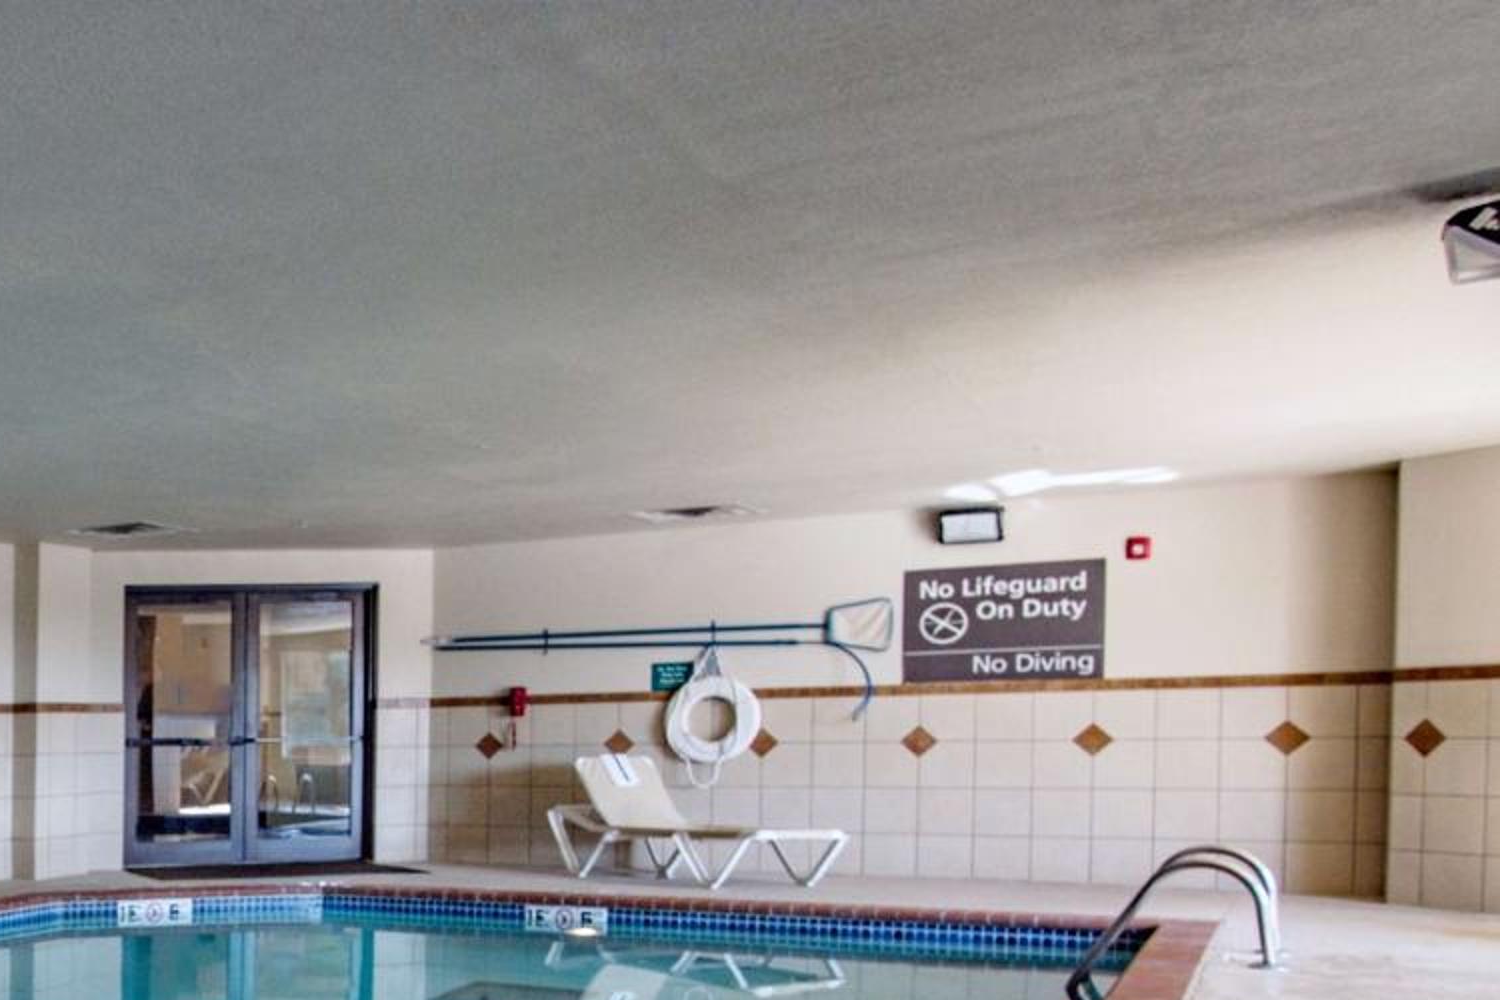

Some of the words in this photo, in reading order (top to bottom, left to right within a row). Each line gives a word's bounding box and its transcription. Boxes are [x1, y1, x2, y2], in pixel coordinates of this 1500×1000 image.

[919, 579, 955, 600] No
[961, 570, 1088, 599] Lifeguard
[975, 600, 1014, 620] On
[1021, 598, 1088, 621] Duty
[971, 655, 1008, 674] No
[1015, 652, 1095, 675] Diving
